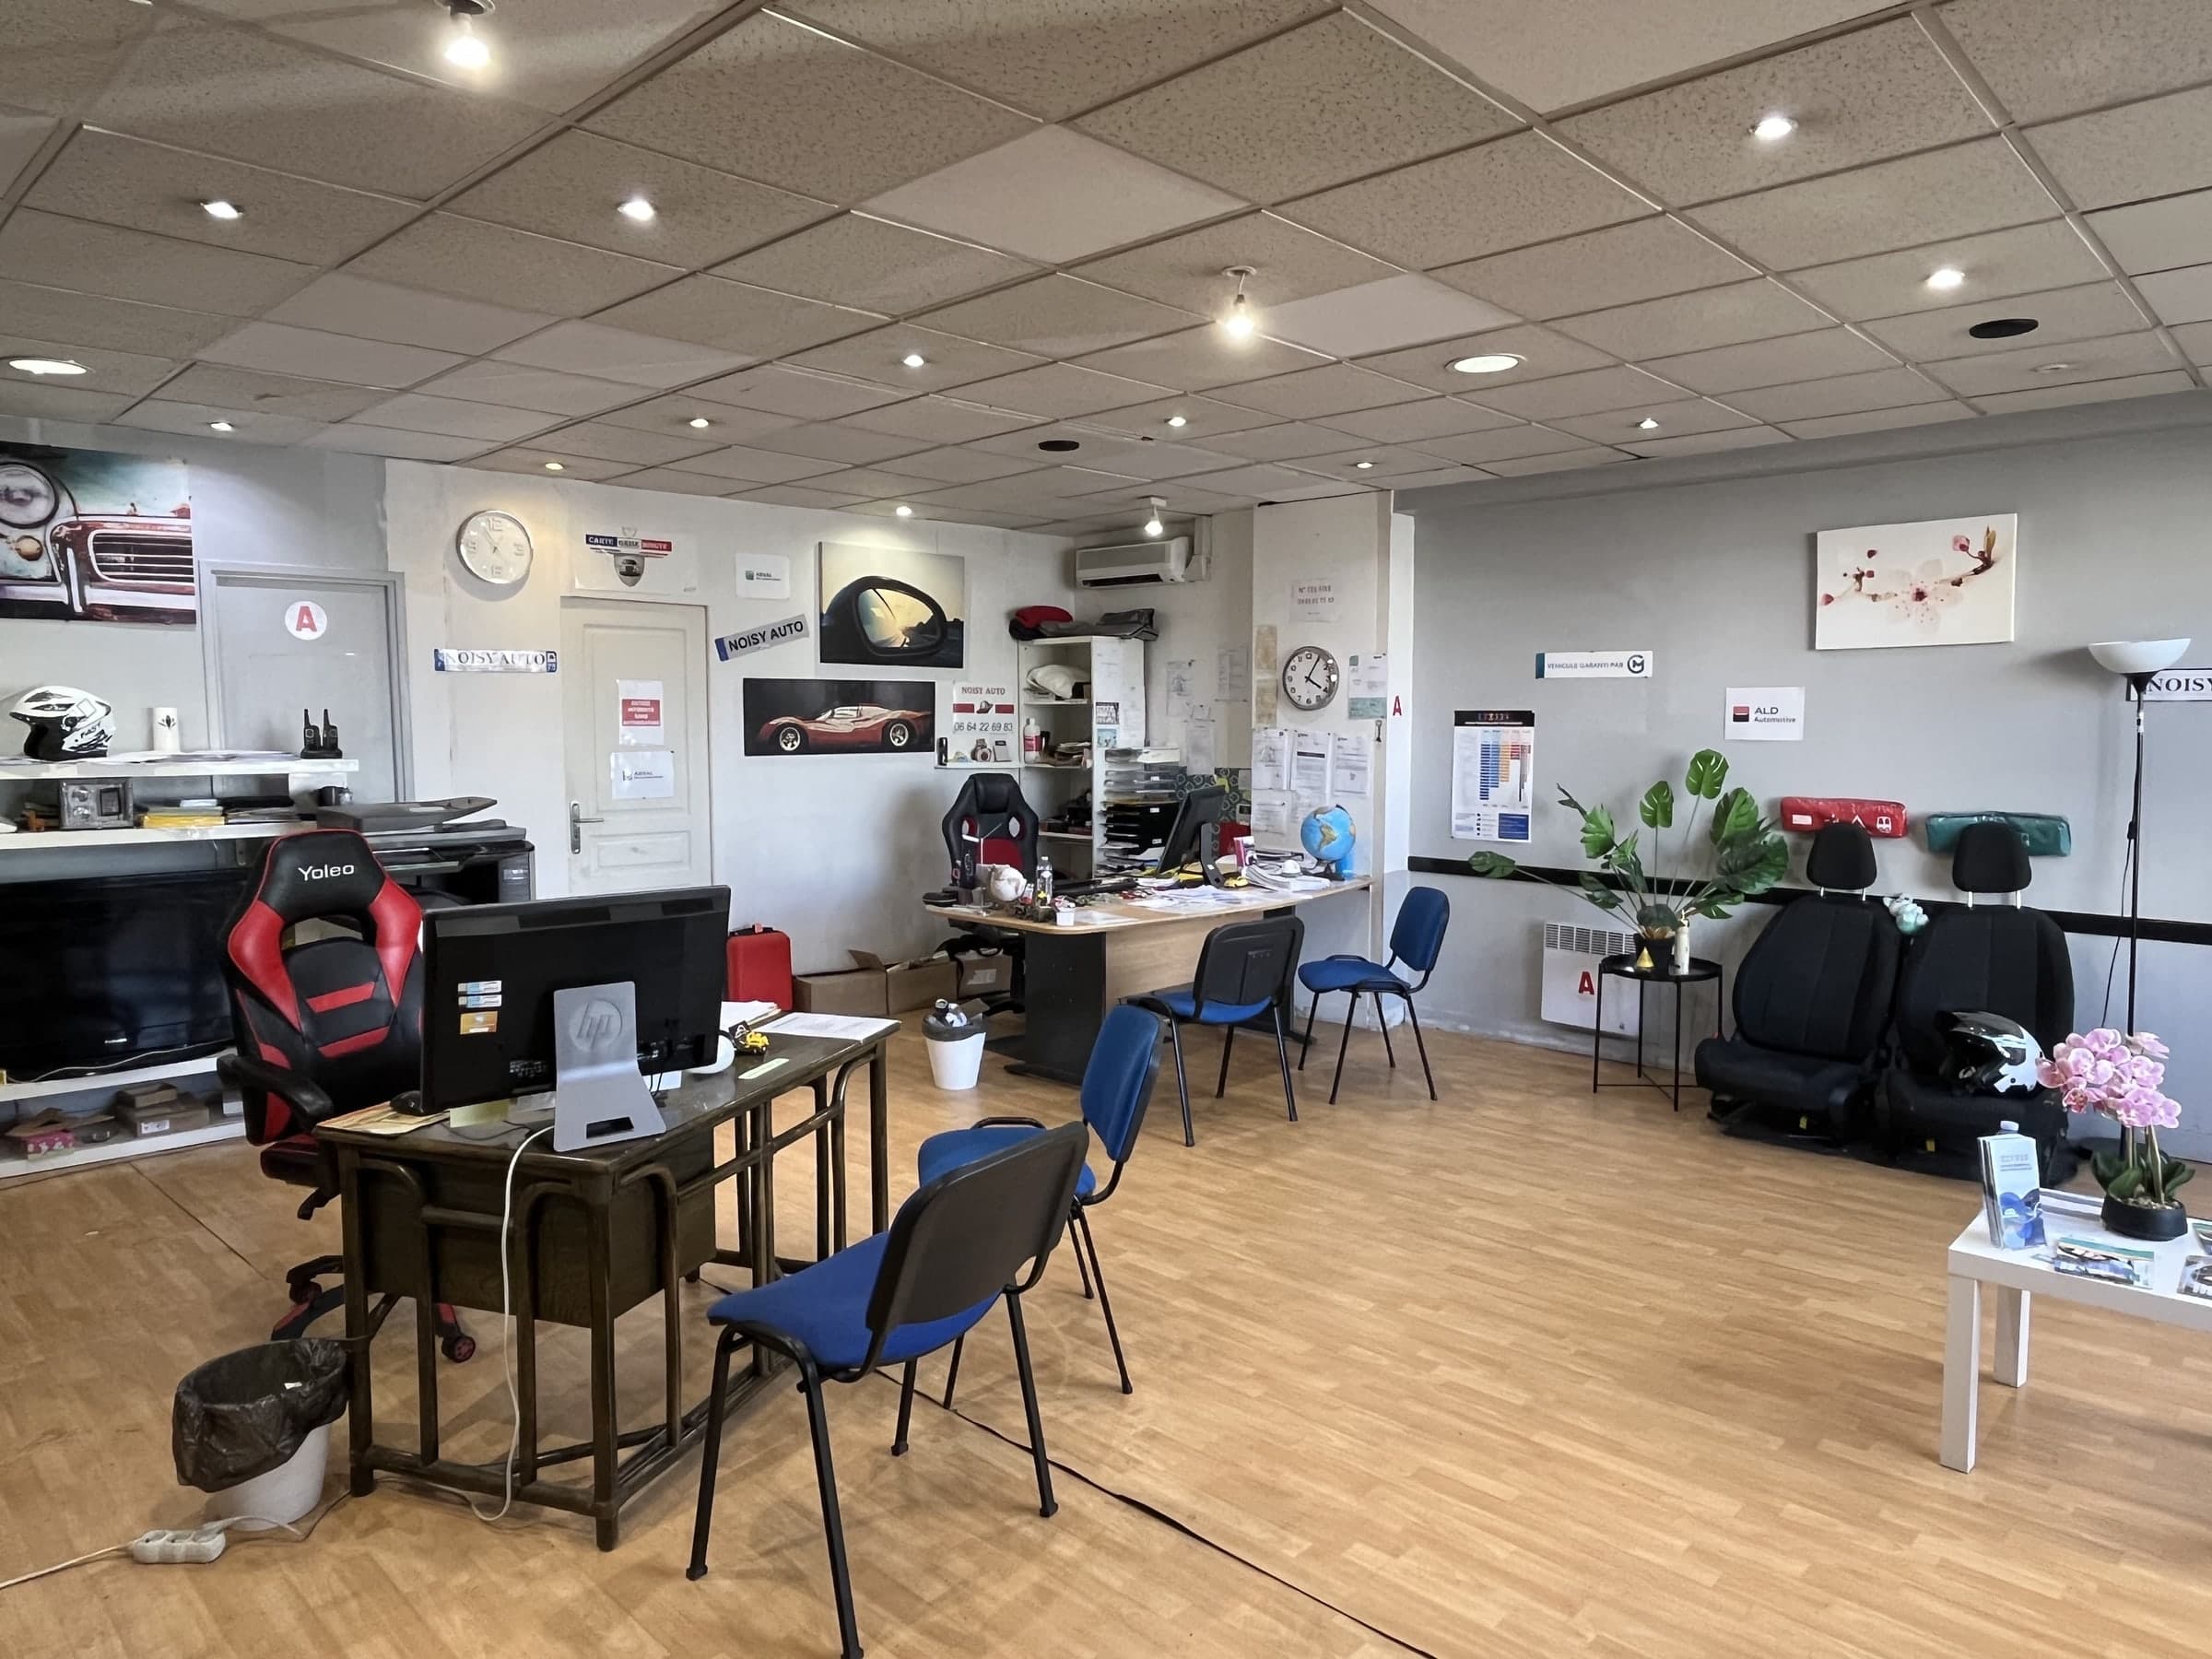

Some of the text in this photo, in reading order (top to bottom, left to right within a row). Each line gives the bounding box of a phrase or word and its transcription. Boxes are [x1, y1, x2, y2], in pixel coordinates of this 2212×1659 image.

[295, 606, 318, 632] A
[727, 620, 804, 652] NOISY AUTO
[961, 687, 1006, 695] NOISY AUTO
[1393, 695, 1402, 716] A
[1754, 706, 1779, 715] ALD
[980, 722, 989, 732] 22
[298, 864, 355, 881] Yoleo
[1578, 971, 1595, 995] A
